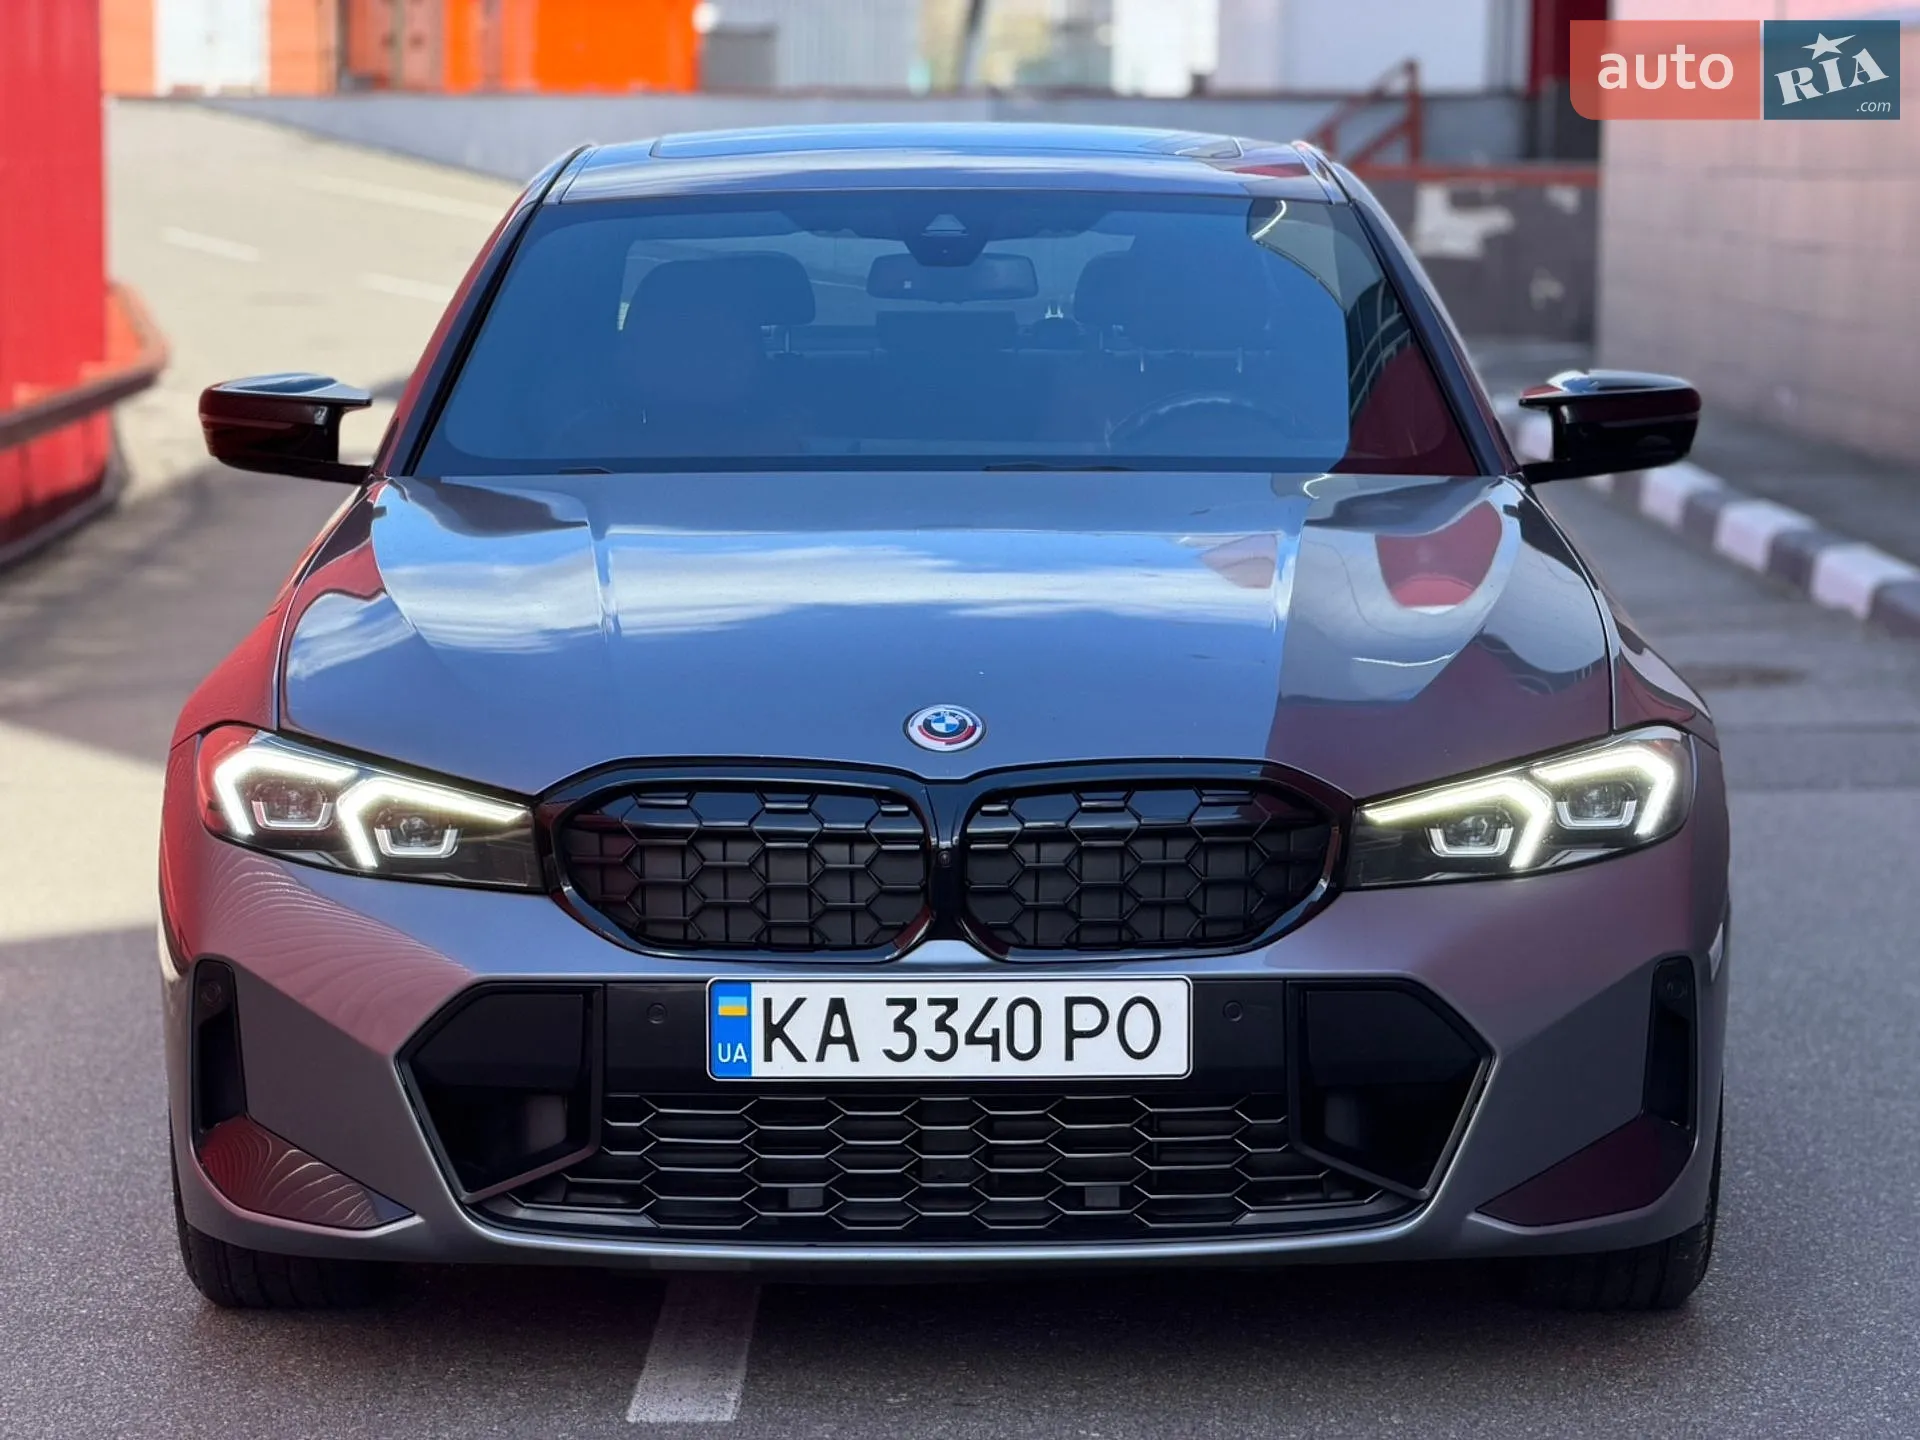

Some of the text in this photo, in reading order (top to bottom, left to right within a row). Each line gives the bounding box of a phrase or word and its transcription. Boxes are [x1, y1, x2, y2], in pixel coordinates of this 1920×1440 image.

[763, 995, 1162, 1062] KA 3340 PO
[717, 1043, 748, 1063] UA
